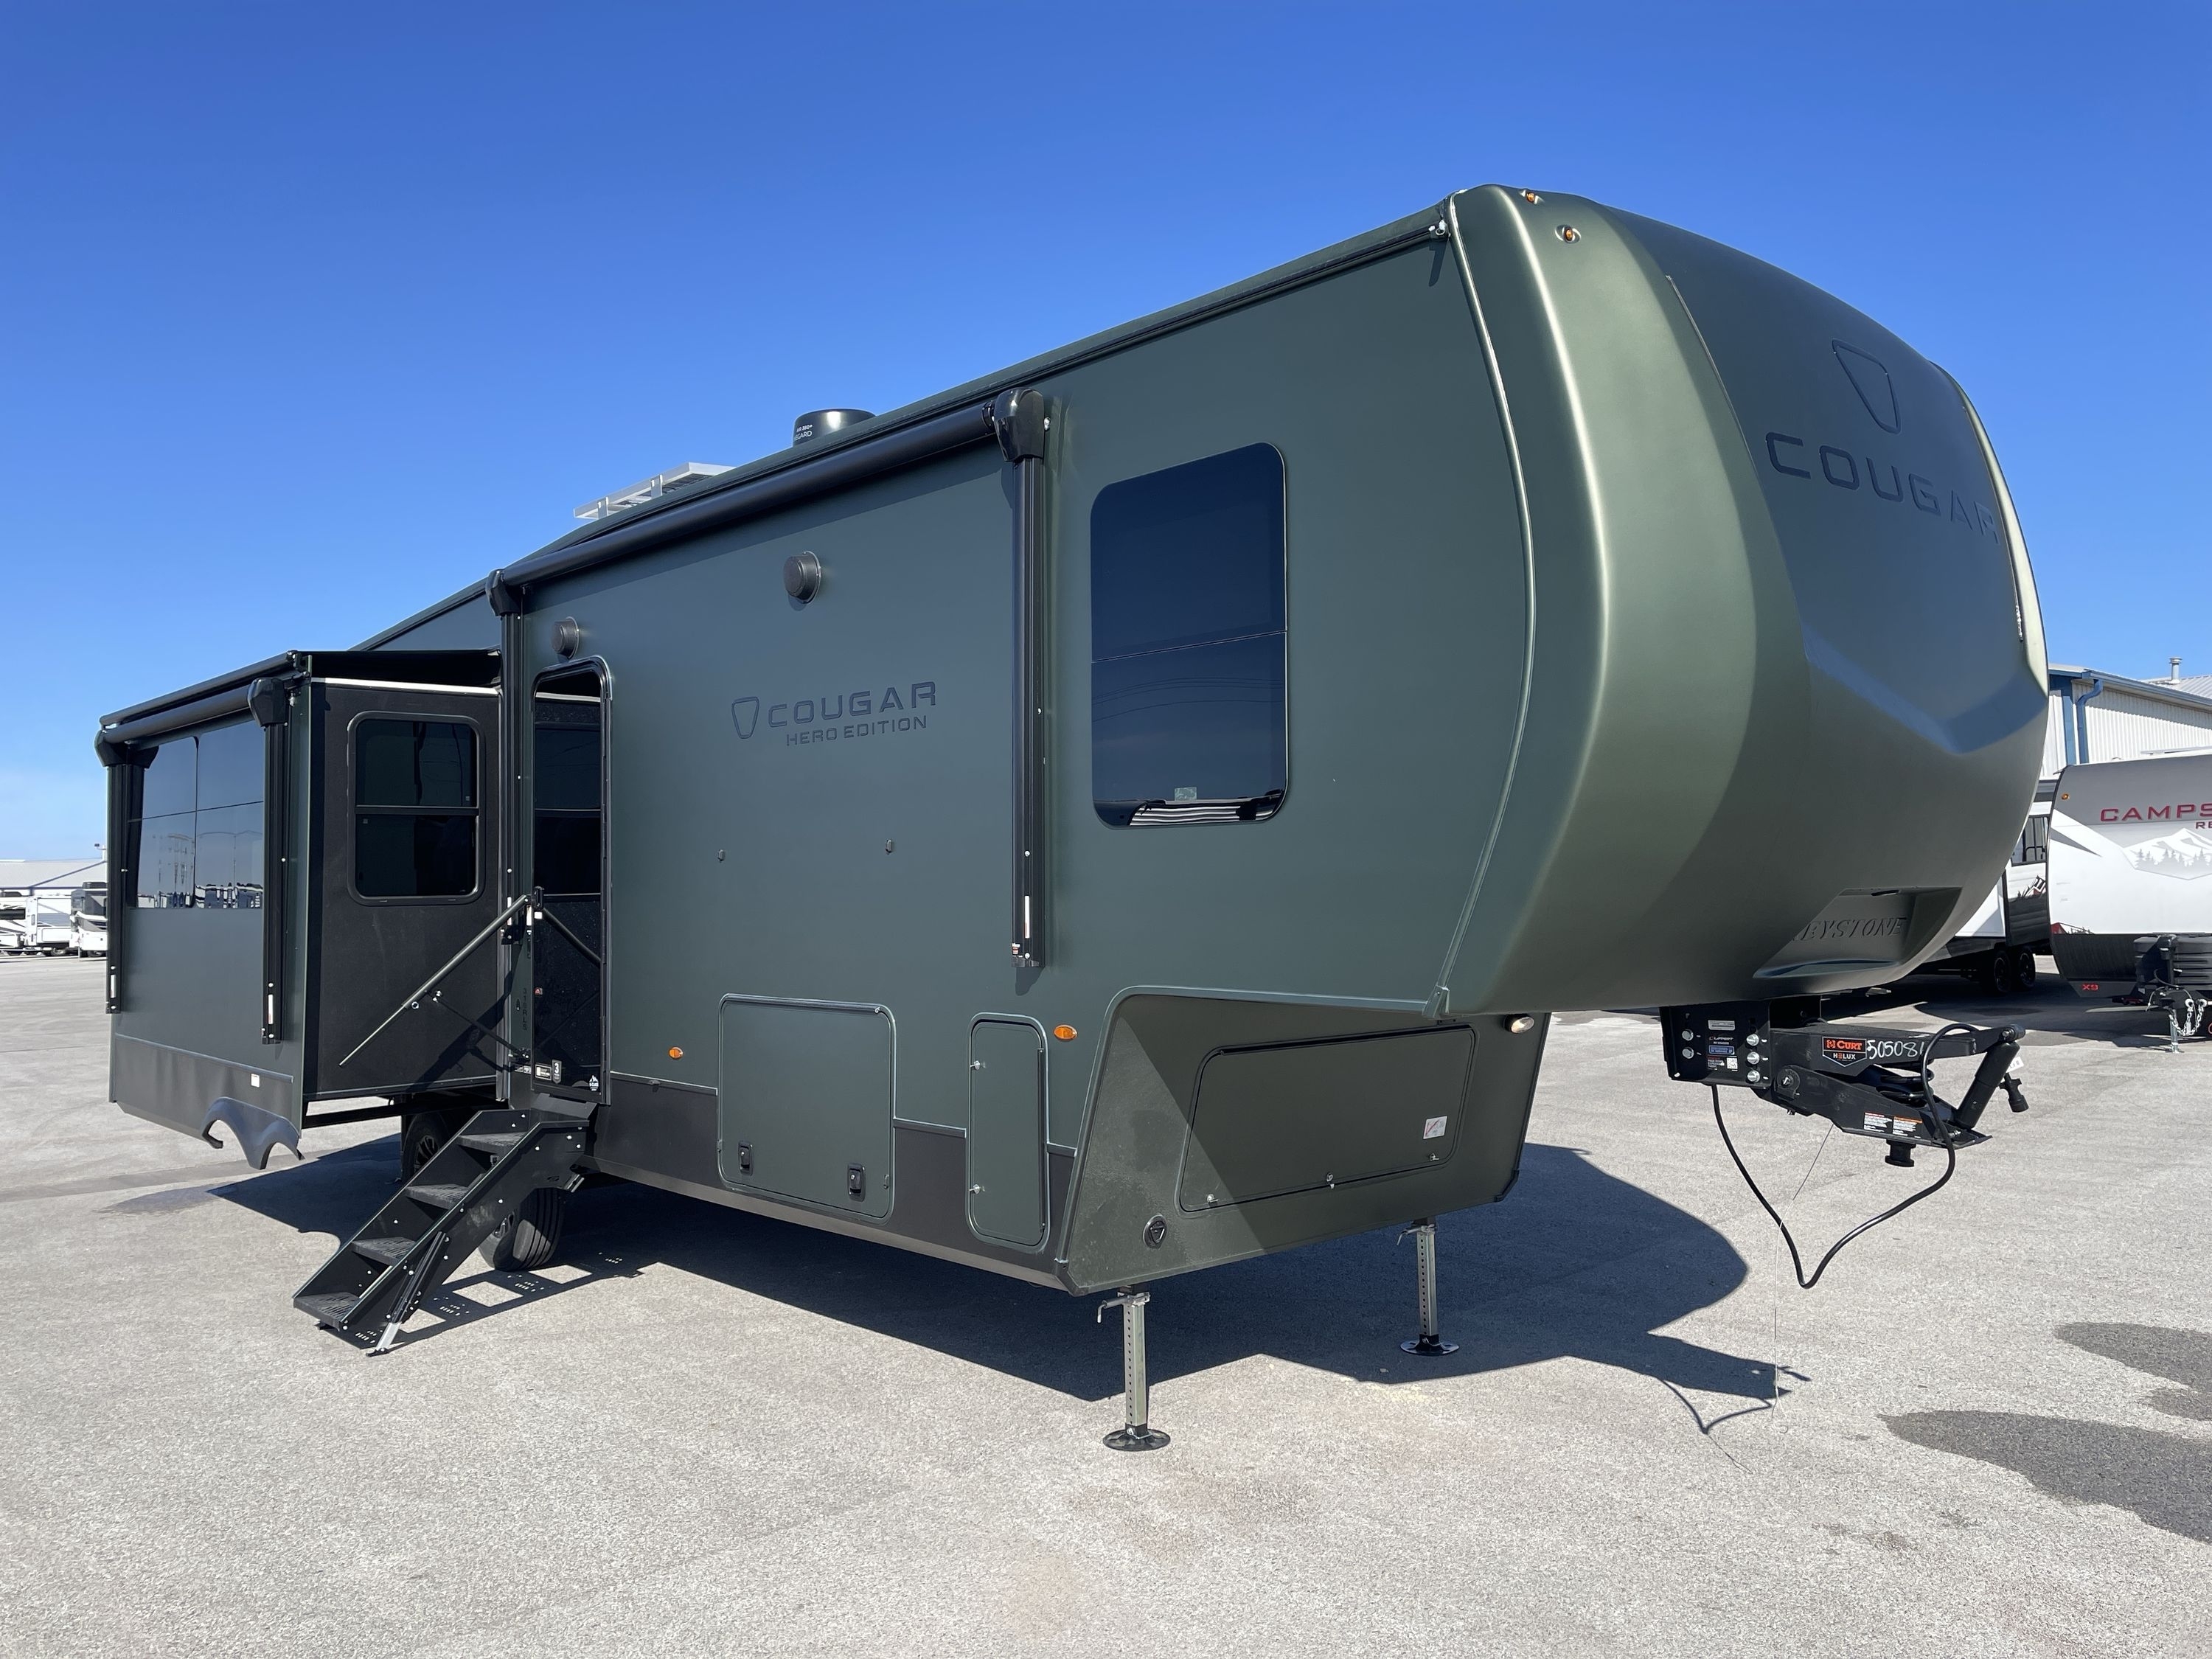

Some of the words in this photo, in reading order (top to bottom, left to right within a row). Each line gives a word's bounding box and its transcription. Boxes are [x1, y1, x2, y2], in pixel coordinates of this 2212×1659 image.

[1765, 431, 2000, 545] COUGAR
[768, 681, 936, 728] COUGAR
[786, 727, 838, 747] HERO
[844, 714, 928, 739] EDITION
[2100, 802, 2212, 822] CAMPS
[1793, 917, 1908, 942] EYSTONE
[1836, 1040, 1863, 1051] CURT
[1866, 1039, 1925, 1060] 505081
